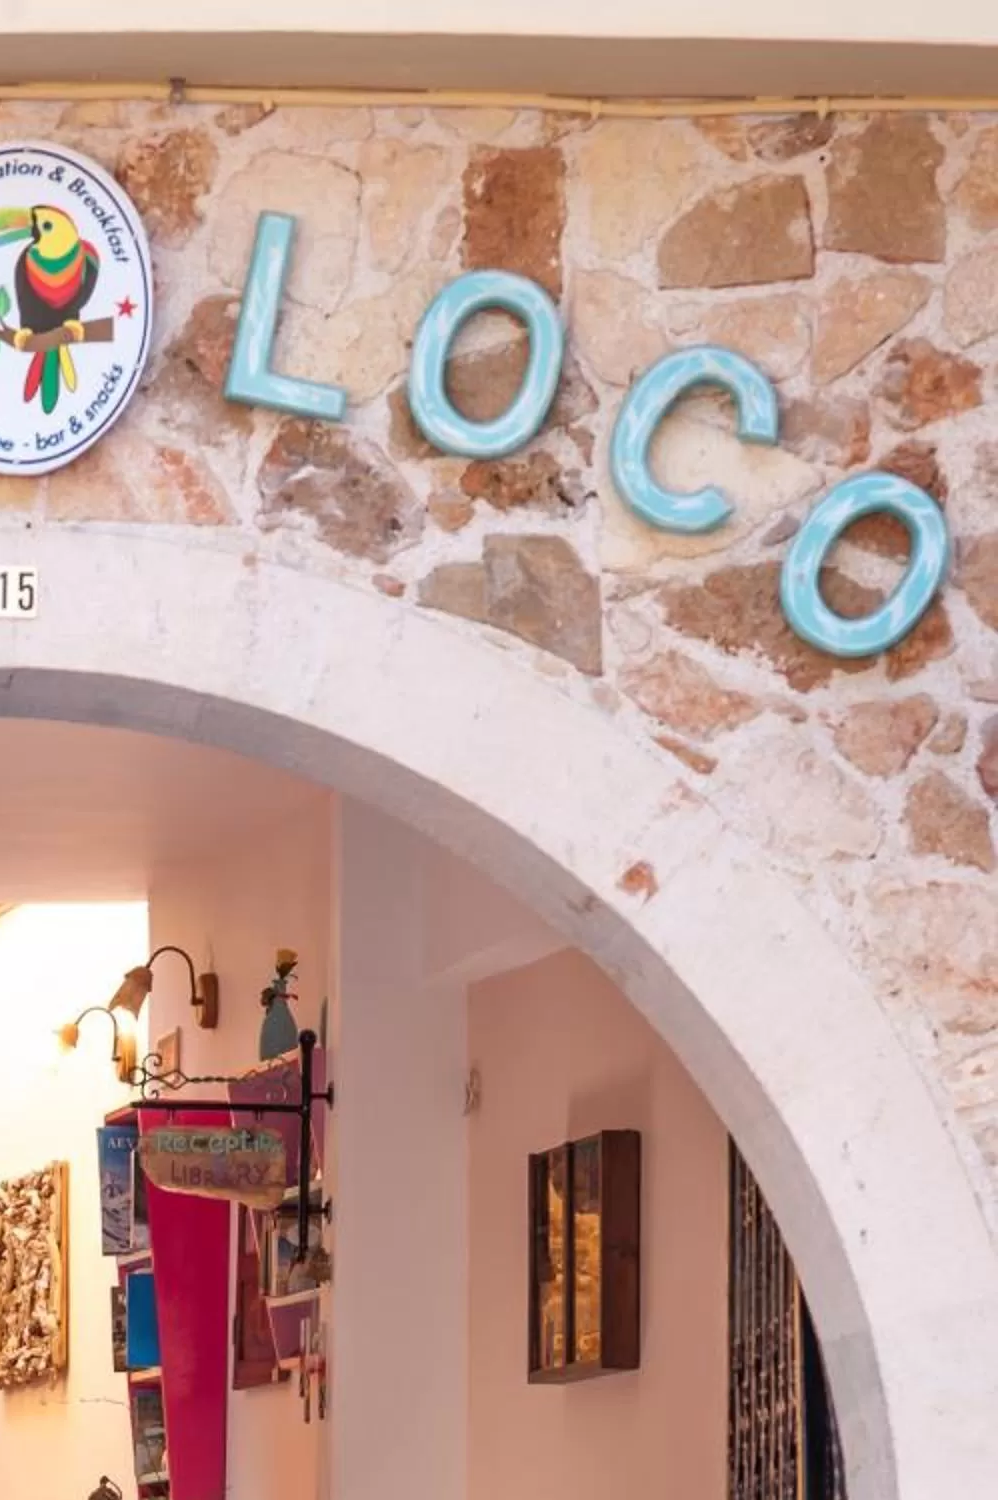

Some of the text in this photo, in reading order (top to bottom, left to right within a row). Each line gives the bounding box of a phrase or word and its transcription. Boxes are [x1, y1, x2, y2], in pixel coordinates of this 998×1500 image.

[47, 165, 65, 182] &
[67, 177, 130, 262] Breakfast
[35, 430, 65, 451] bar
[68, 415, 83, 435] &
[84, 364, 123, 422] snacks
[223, 210, 949, 658] LOCO
